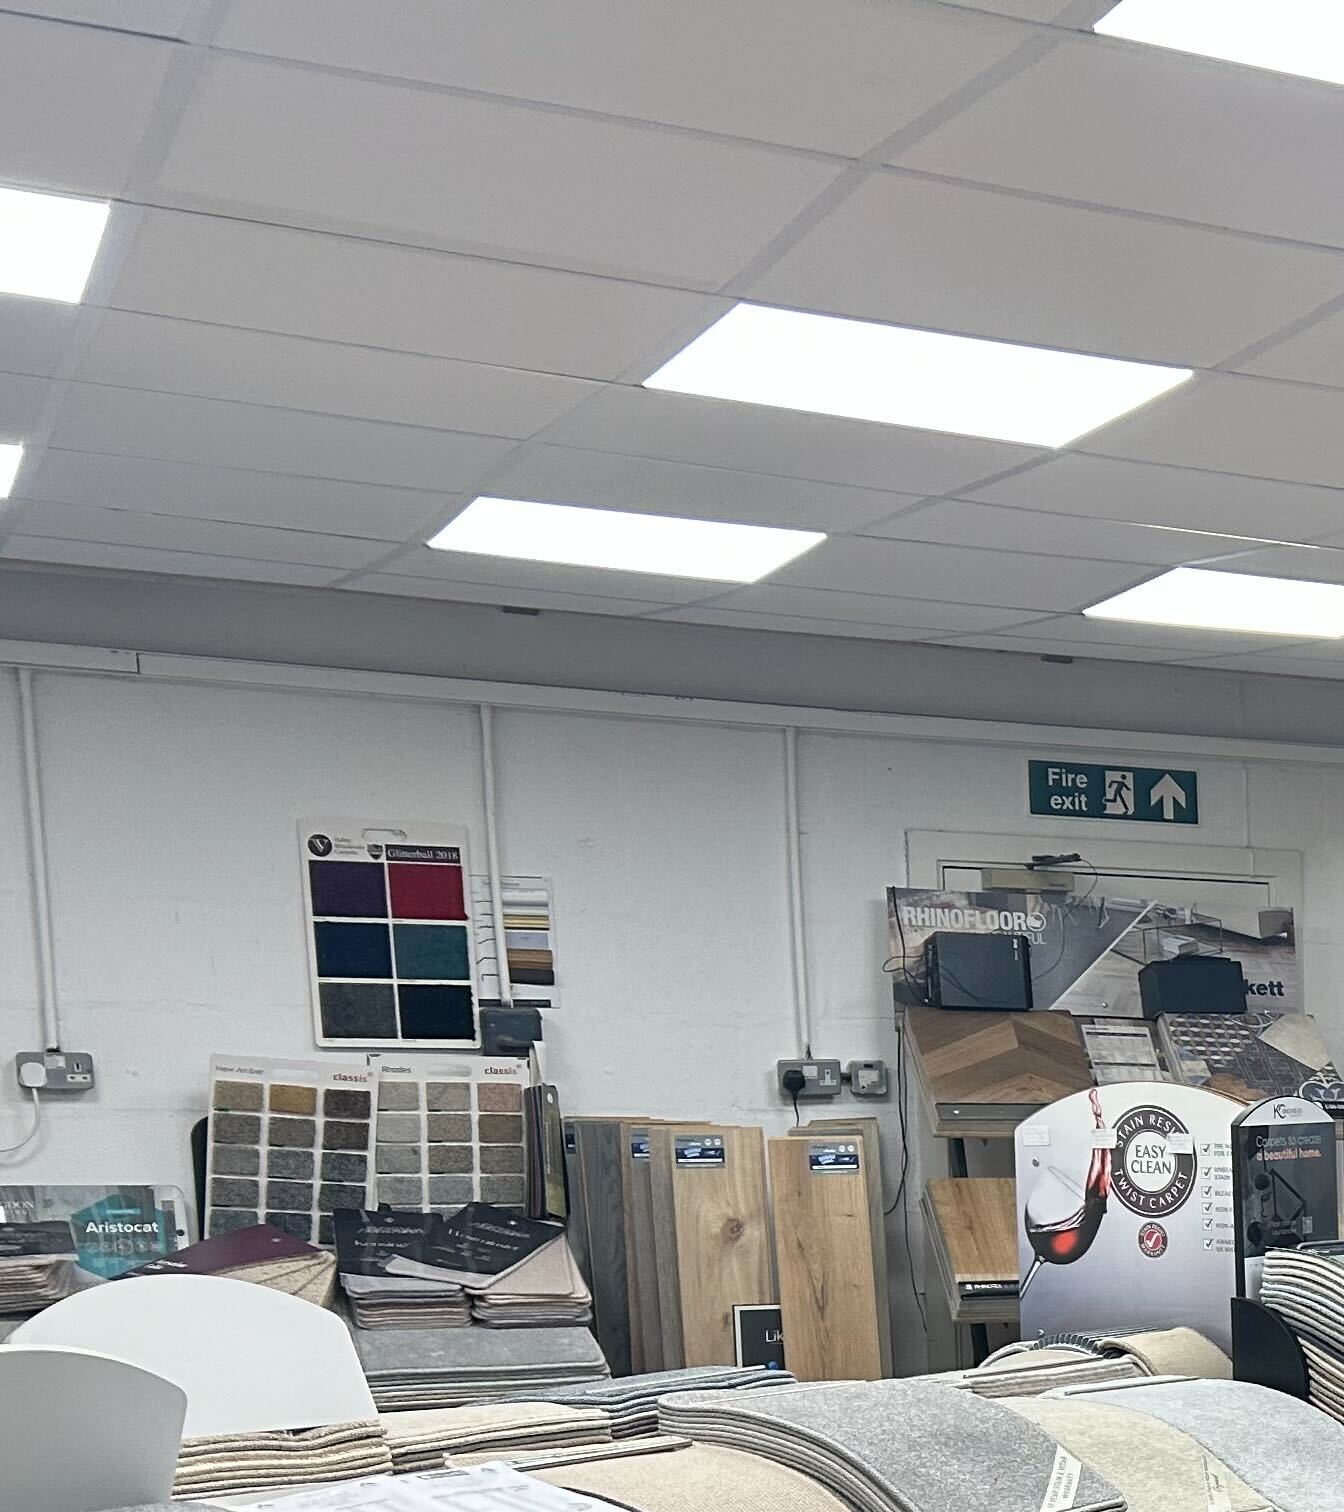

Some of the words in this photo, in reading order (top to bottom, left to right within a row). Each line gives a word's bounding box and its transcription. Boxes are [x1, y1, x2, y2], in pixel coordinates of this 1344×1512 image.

[1047, 767, 1088, 789] Fire
[1050, 792, 1088, 811] exit
[388, 849, 434, 861] Glitterball
[436, 851, 459, 861] 2018
[902, 906, 1027, 932] RHINOFLOOR
[215, 1064, 235, 1074] New
[484, 1066, 518, 1076] classis
[333, 1072, 368, 1083] classis
[1116, 1114, 1144, 1148] STAIN
[1256, 1135, 1287, 1148] Carpets
[1288, 1136, 1296, 1145] to
[1136, 1145, 1166, 1159] EASY
[1257, 1153, 1263, 1161] a
[1265, 1150, 1298, 1160] beautiful
[1299, 1149, 1322, 1159] home.
[1131, 1160, 1171, 1175] CLEAN
[1114, 1169, 1145, 1206] TWIST
[1149, 1172, 1188, 1209] CARPET
[85, 1221, 159, 1233] Aristocat
